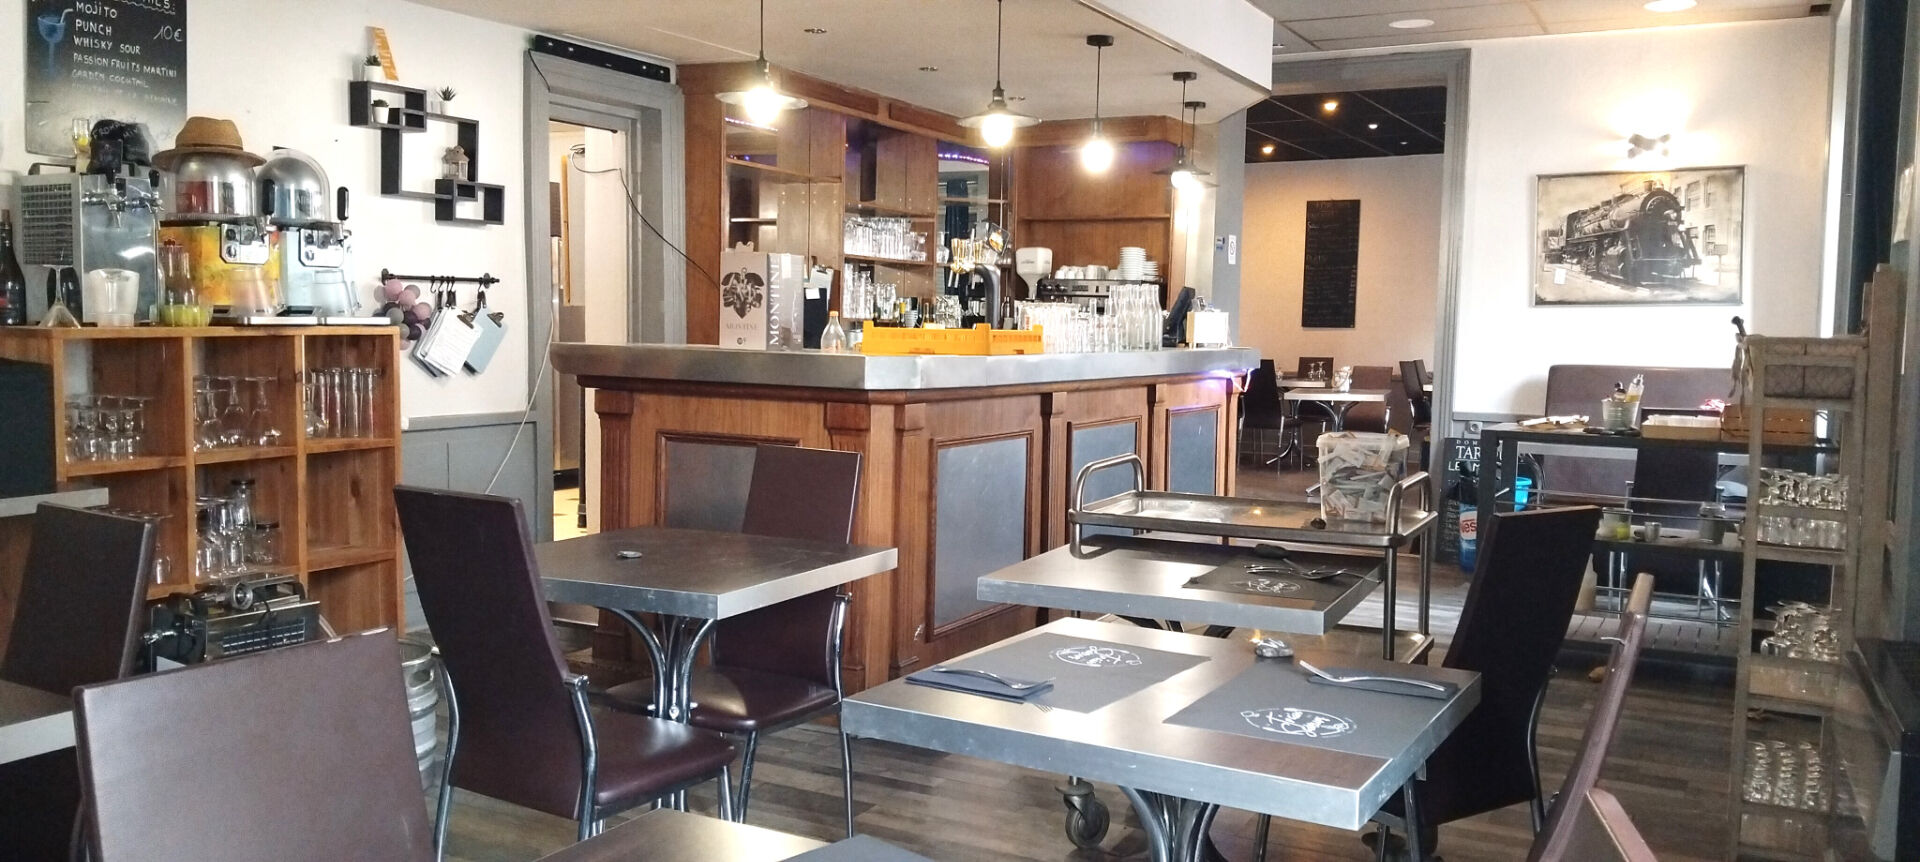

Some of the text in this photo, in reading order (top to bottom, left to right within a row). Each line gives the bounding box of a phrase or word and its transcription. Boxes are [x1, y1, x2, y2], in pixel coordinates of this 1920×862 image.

[75, 20, 113, 36] PUNCH
[153, 25, 183, 43] 10€
[73, 35, 141, 55] WHISKY SOUR
[73, 52, 177, 79] PASSION FRUITS MARTINI
[769, 254, 781, 345] MONTINE
